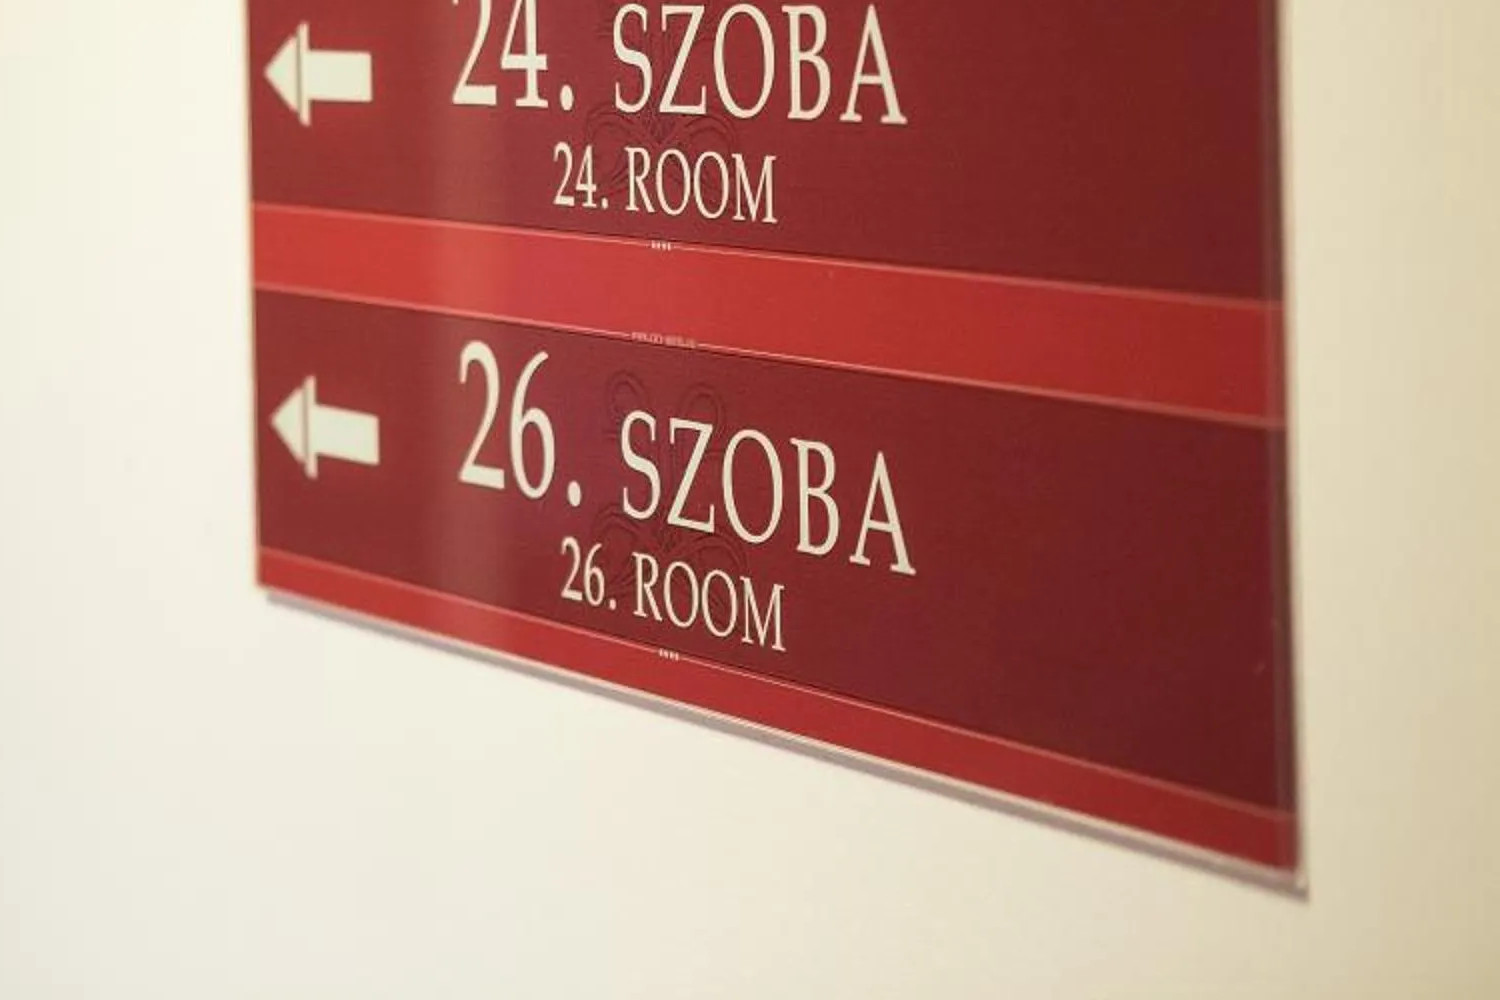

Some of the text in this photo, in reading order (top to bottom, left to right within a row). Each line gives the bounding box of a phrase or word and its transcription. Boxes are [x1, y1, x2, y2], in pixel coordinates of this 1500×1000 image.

[613, 3, 907, 125] SZOBA
[553, 141, 778, 224] 24. ROOM
[458, 339, 916, 575] 26. SZOBA
[561, 536, 786, 652] 26. ROOM
